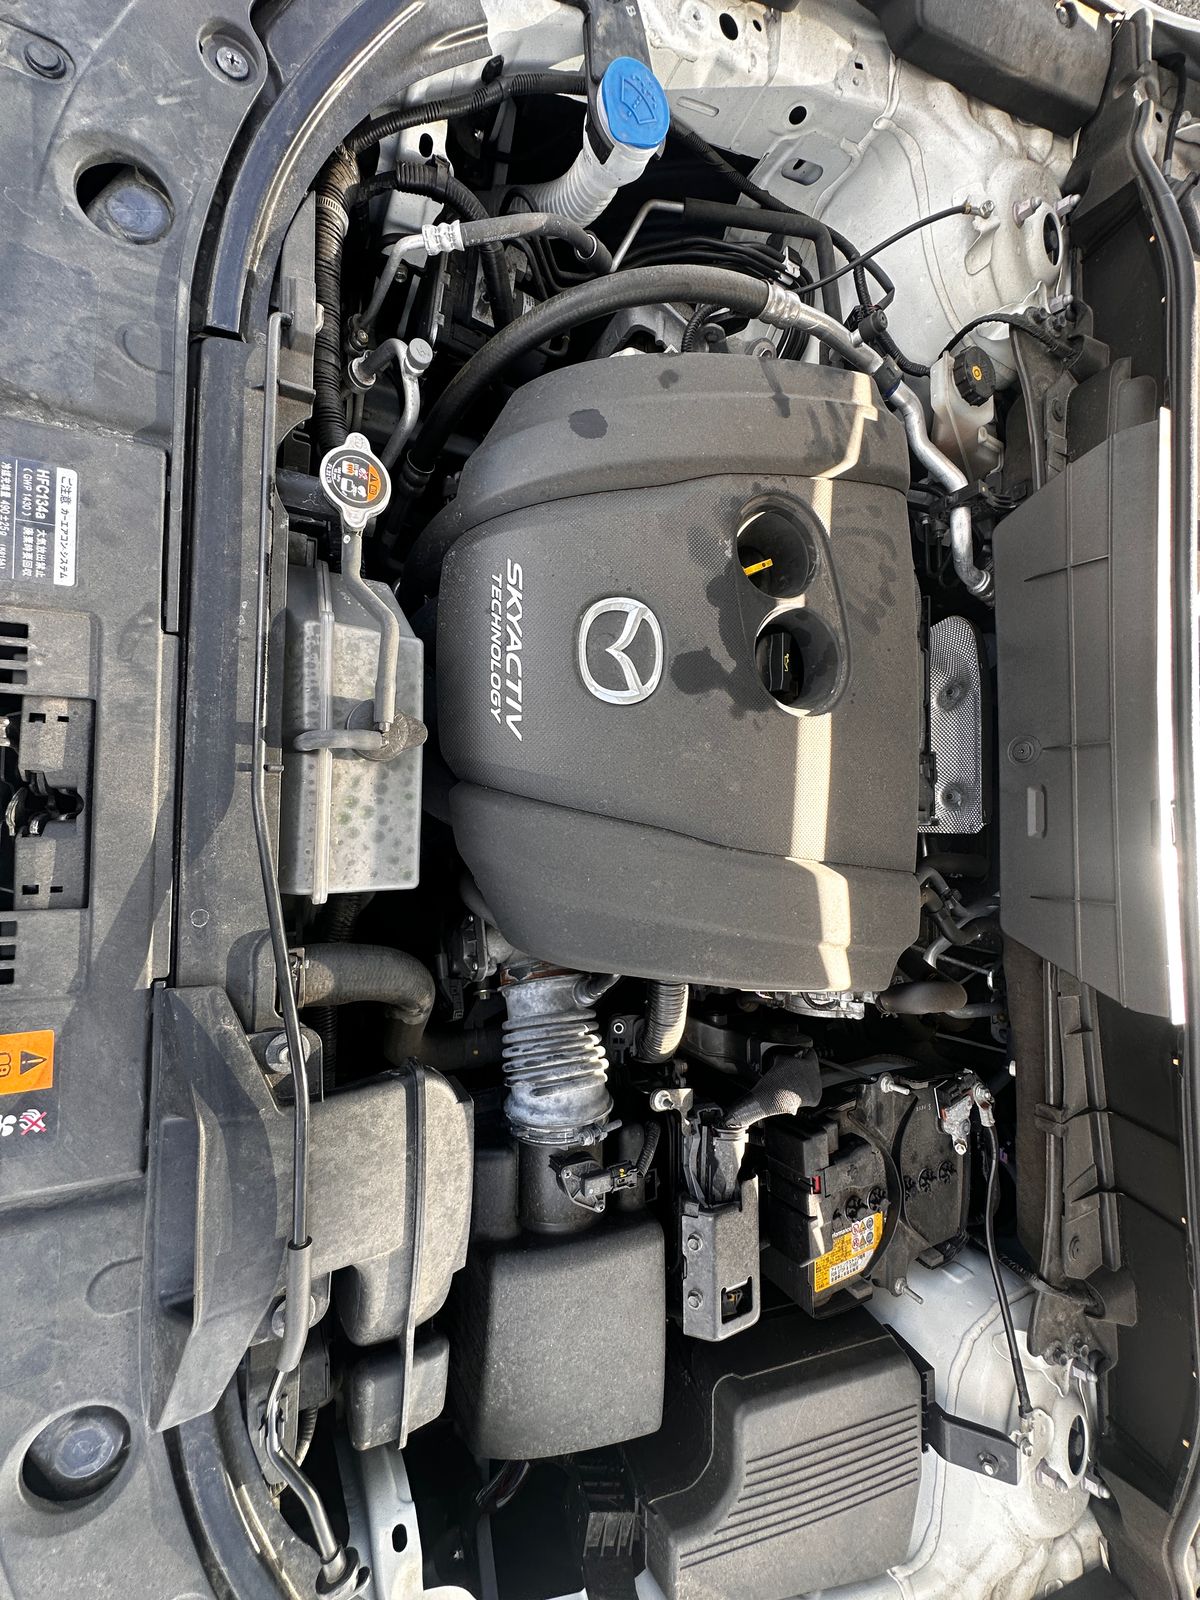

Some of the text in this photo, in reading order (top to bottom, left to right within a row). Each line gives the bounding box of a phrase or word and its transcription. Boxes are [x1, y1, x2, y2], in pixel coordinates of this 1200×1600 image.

[35, 469, 50, 519] HFC134a
[60, 476, 73, 506] ご注意
[35, 528, 48, 578] 大気放出禁止
[490, 573, 503, 724] TECHNOLOGY
[505, 557, 523, 742] SKYACTIV
